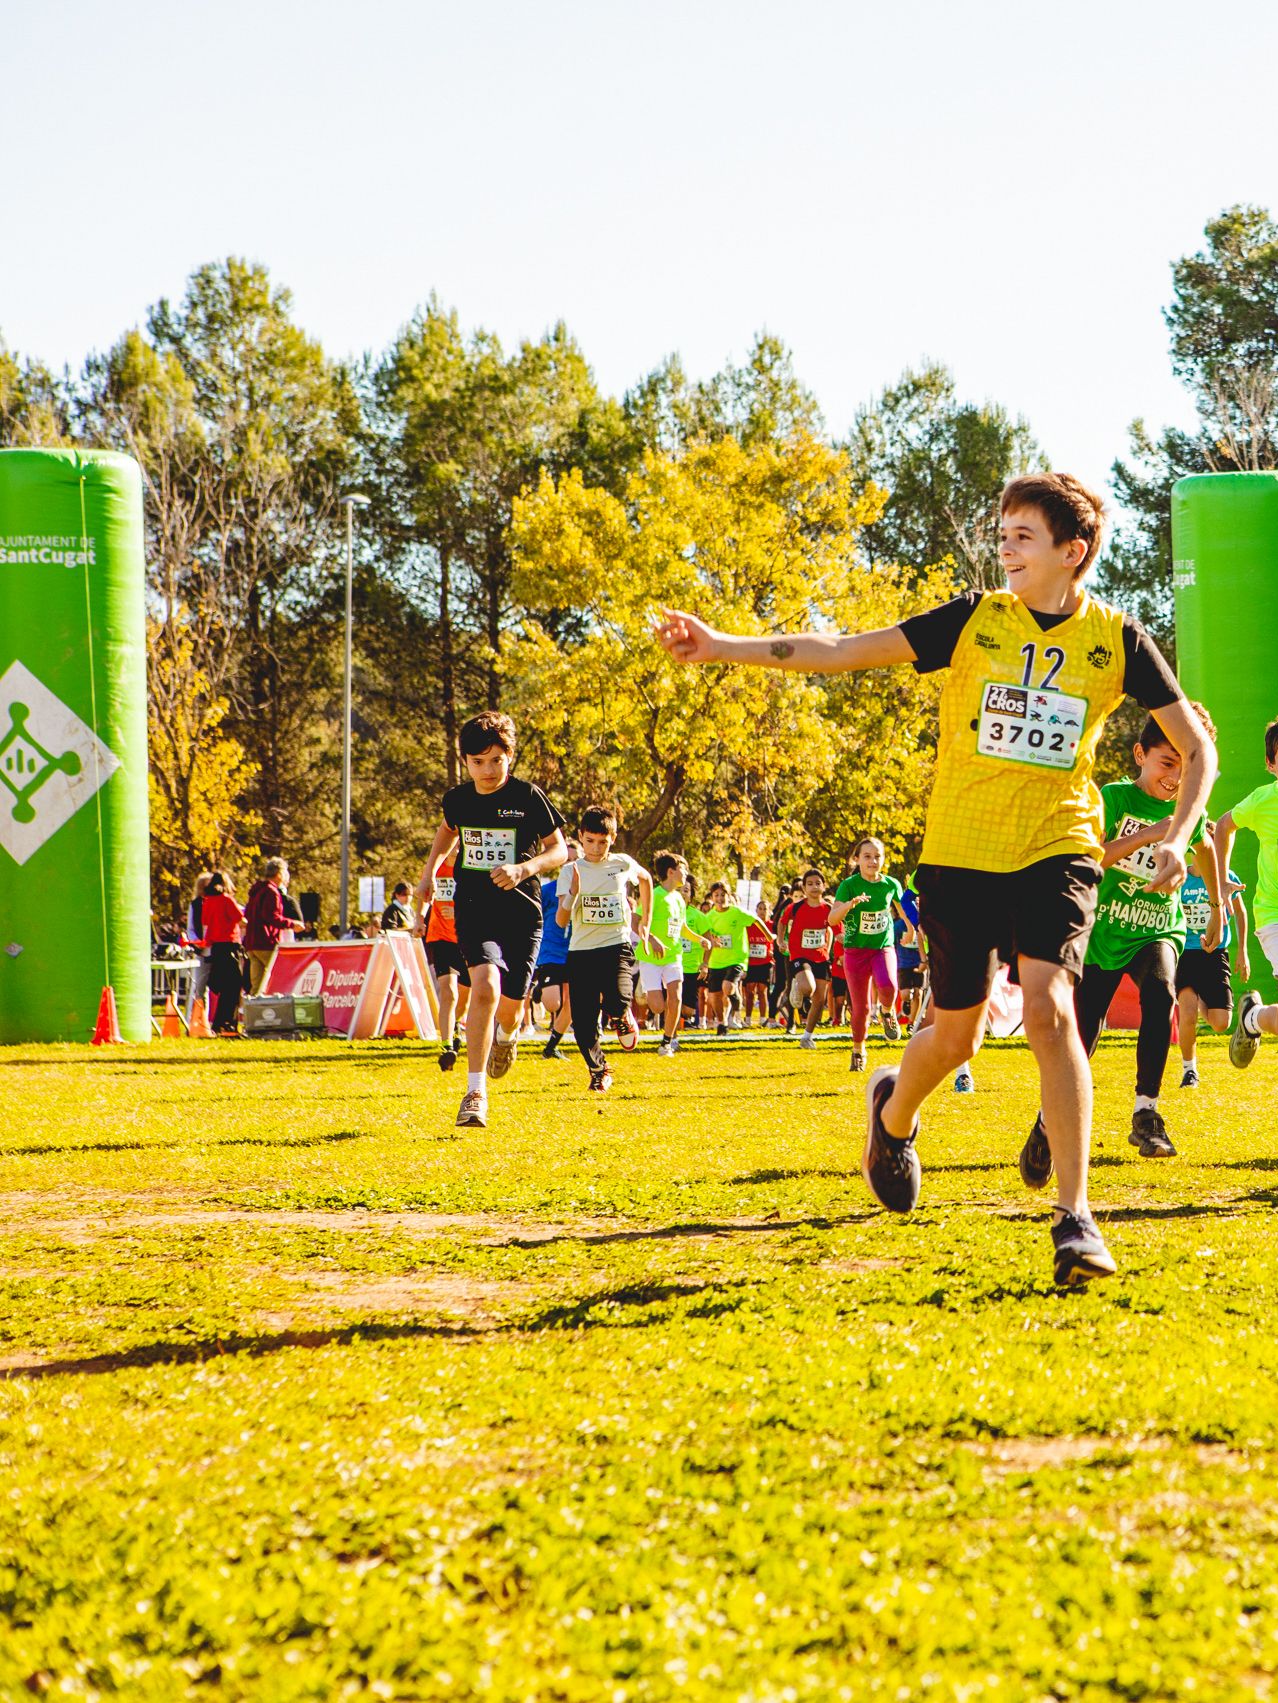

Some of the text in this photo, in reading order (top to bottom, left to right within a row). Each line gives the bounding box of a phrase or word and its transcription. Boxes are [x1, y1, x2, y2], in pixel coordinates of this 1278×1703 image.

[80, 536, 97, 549] DE
[0, 547, 97, 568] SantCugat
[1020, 642, 1065, 691] 12
[988, 697, 1025, 714] CROS
[989, 722, 1065, 752] 3702
[468, 850, 506, 861] 4055
[590, 910, 614, 919] 706
